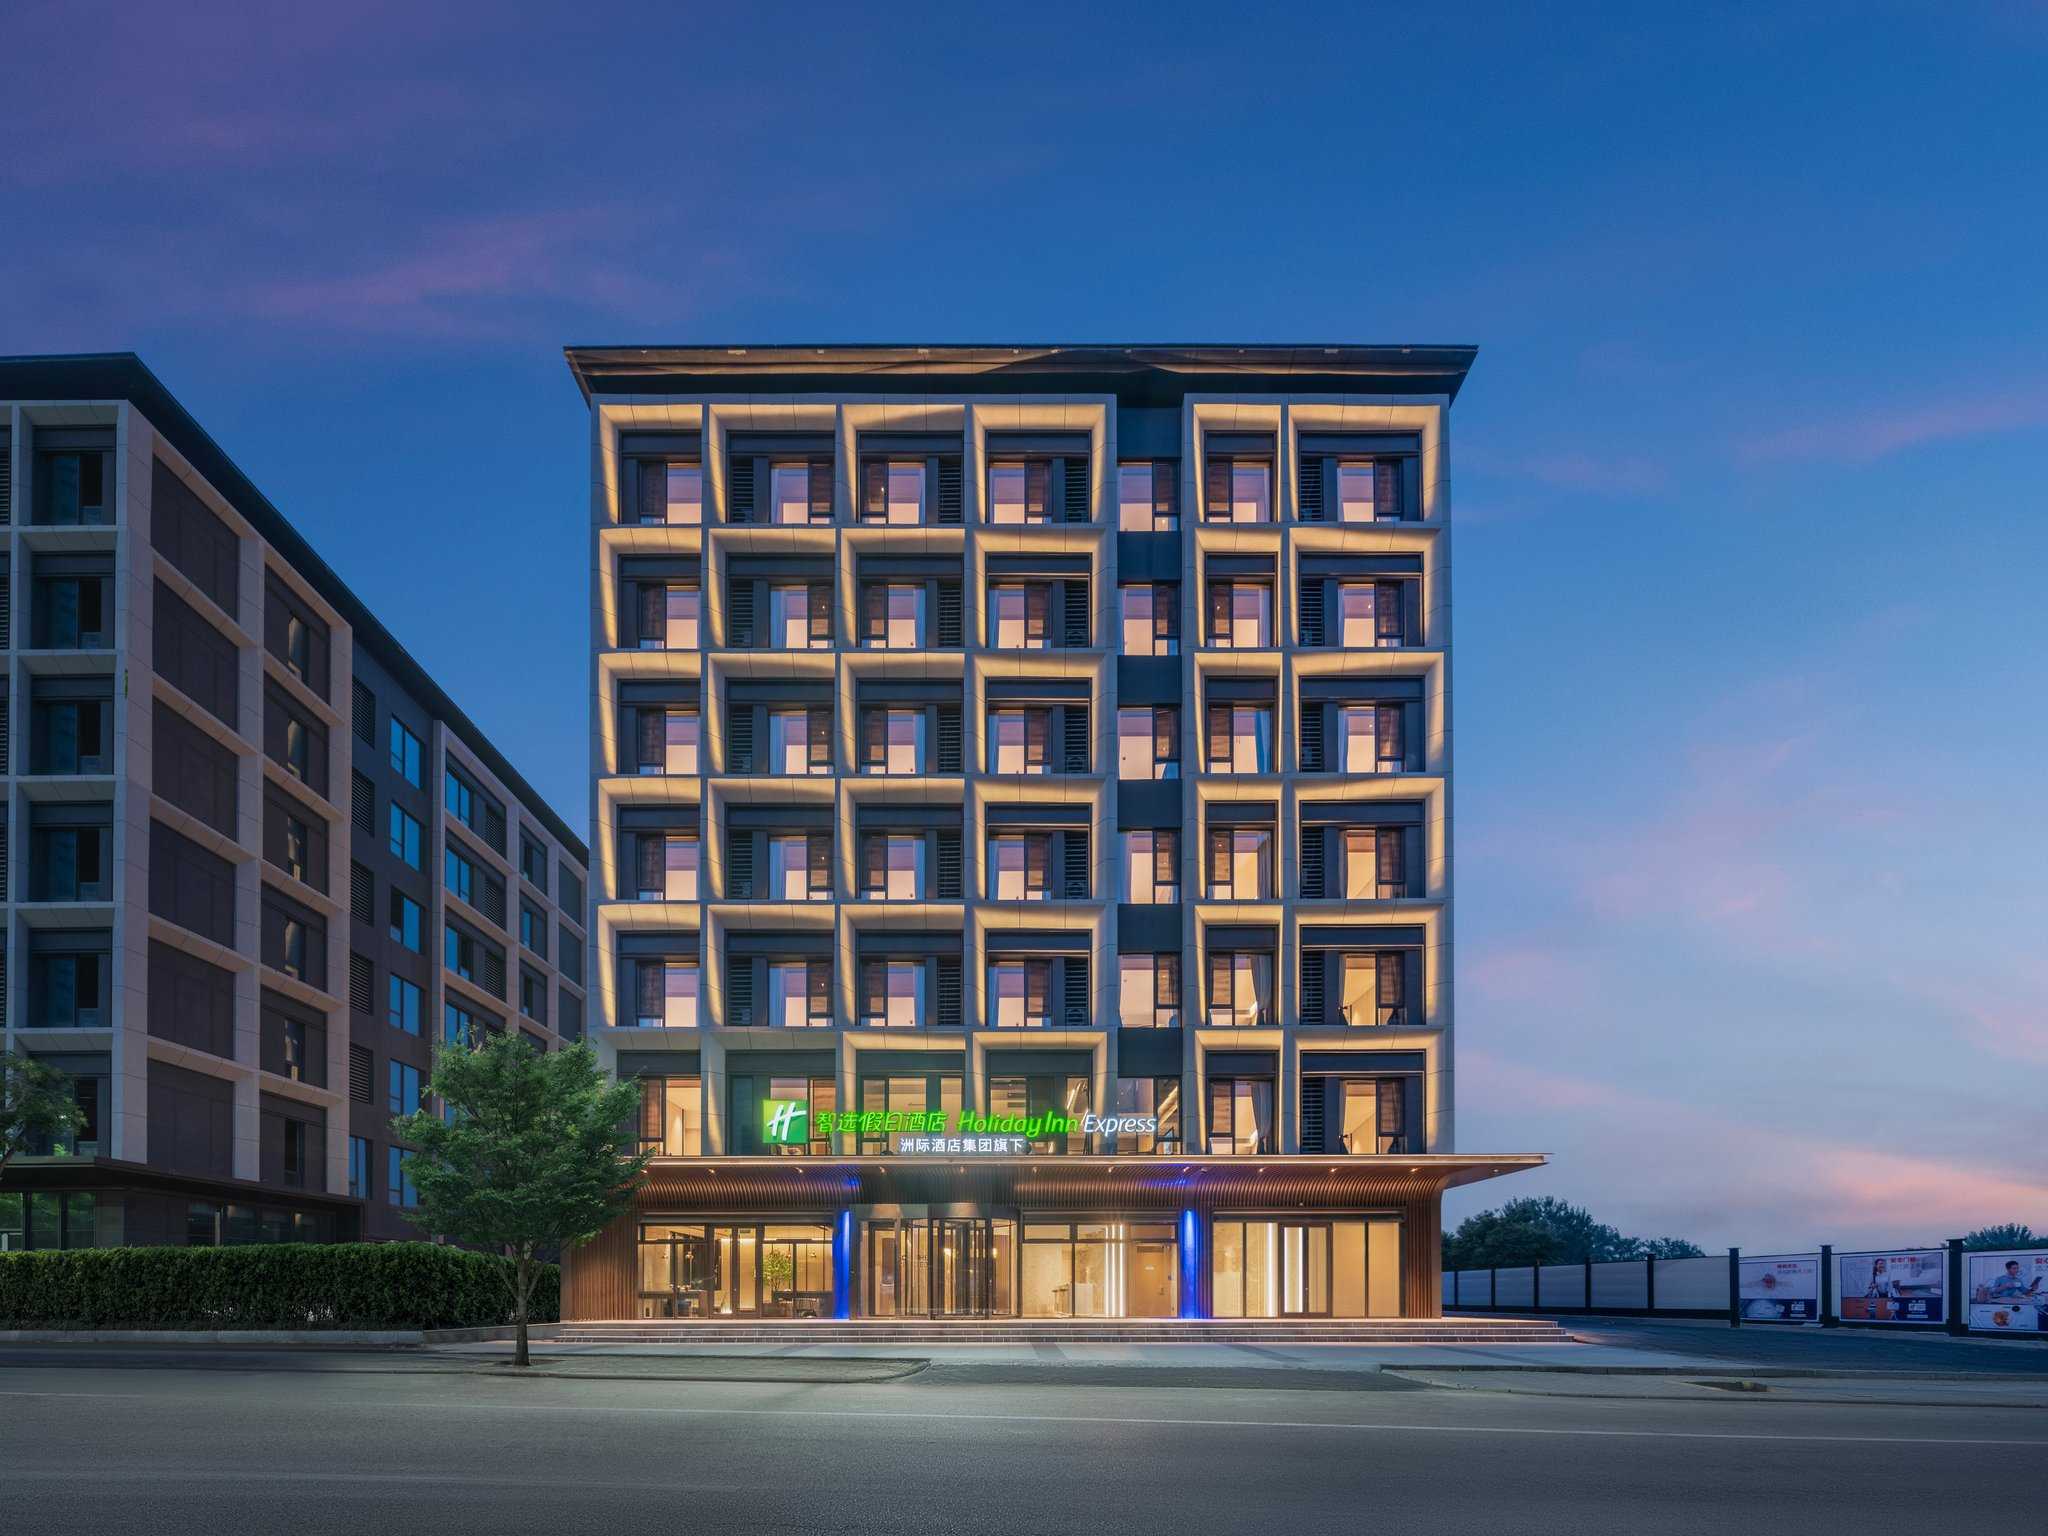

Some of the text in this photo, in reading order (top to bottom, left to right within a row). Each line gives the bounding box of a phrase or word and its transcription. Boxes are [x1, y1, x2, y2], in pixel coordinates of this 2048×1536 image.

[816, 1112, 948, 1132] 智选假日酒店
[958, 1110, 1157, 1138] Holiday Inn Express
[900, 1138, 1024, 1153] 洲际酒店集团旗下
